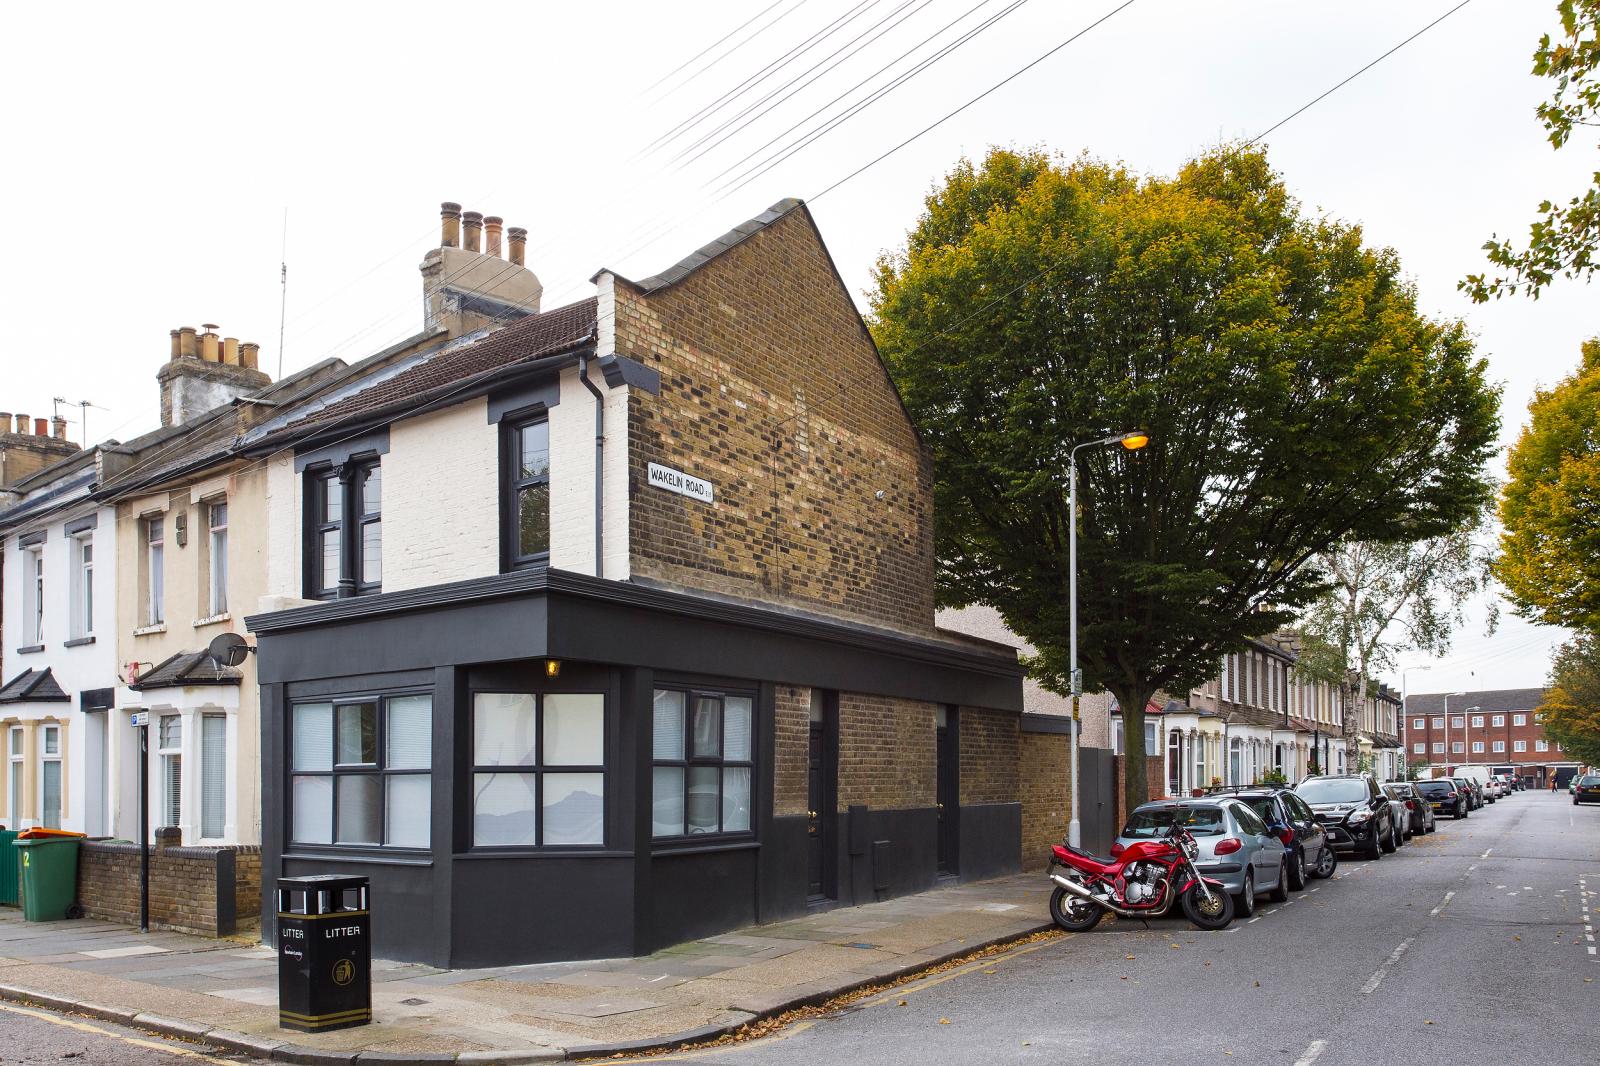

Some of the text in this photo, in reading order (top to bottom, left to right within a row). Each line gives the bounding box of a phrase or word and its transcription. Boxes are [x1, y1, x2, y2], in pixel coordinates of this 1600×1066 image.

[650, 467, 705, 495] WAKELIN ROAD
[23, 851, 30, 867] 2
[282, 928, 304, 939] LITTER
[325, 926, 361, 939] LITTER
